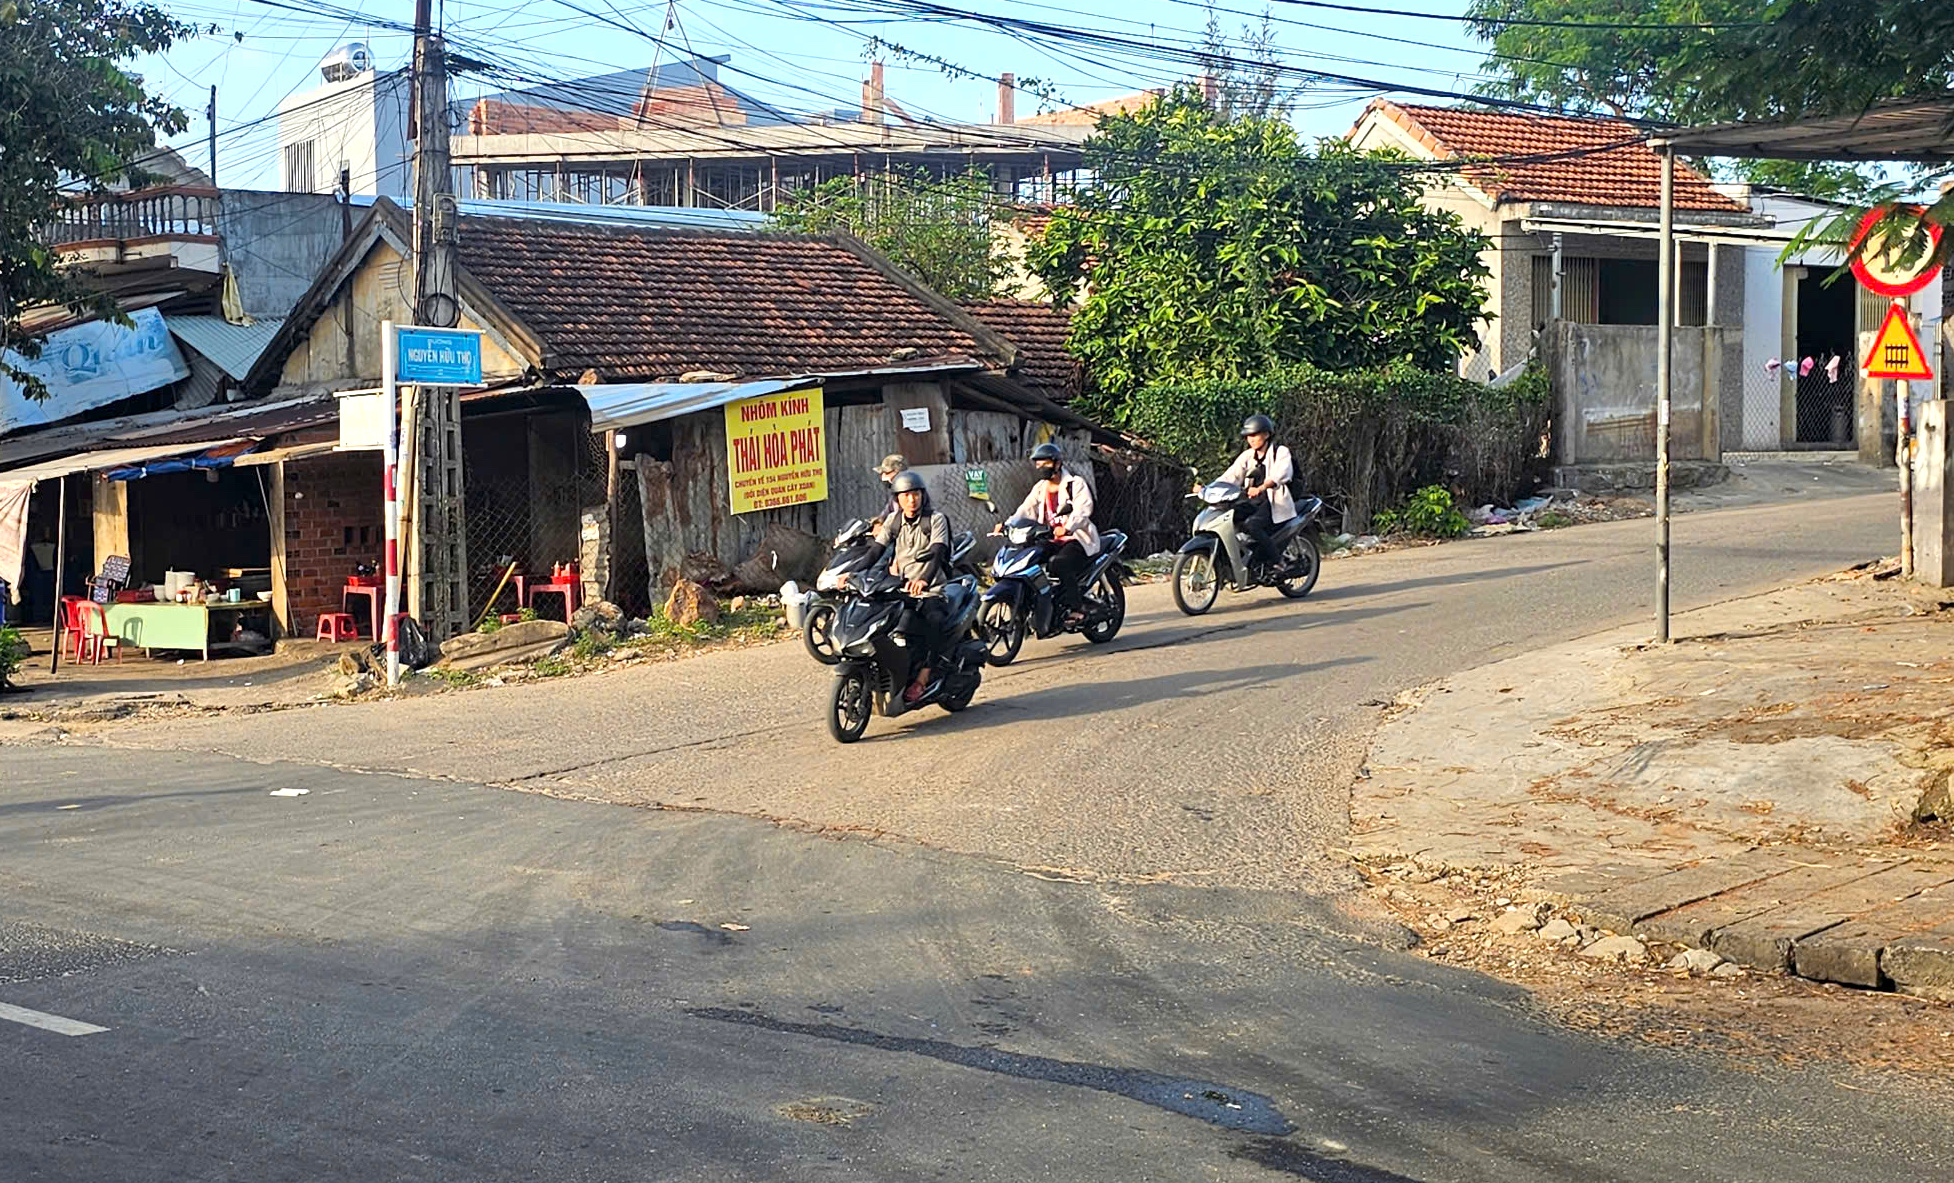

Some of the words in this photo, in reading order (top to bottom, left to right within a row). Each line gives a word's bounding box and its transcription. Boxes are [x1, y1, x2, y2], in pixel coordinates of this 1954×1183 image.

[408, 348, 438, 363] NGUYỄN
[439, 347, 455, 364] HỮU
[456, 350, 472, 367] THỌ
[740, 400, 777, 422] NHÔM
[780, 396, 809, 417] KÍNH
[733, 428, 761, 473] THÁI
[763, 423, 788, 469] HÒA
[790, 419, 820, 465] PHÁT
